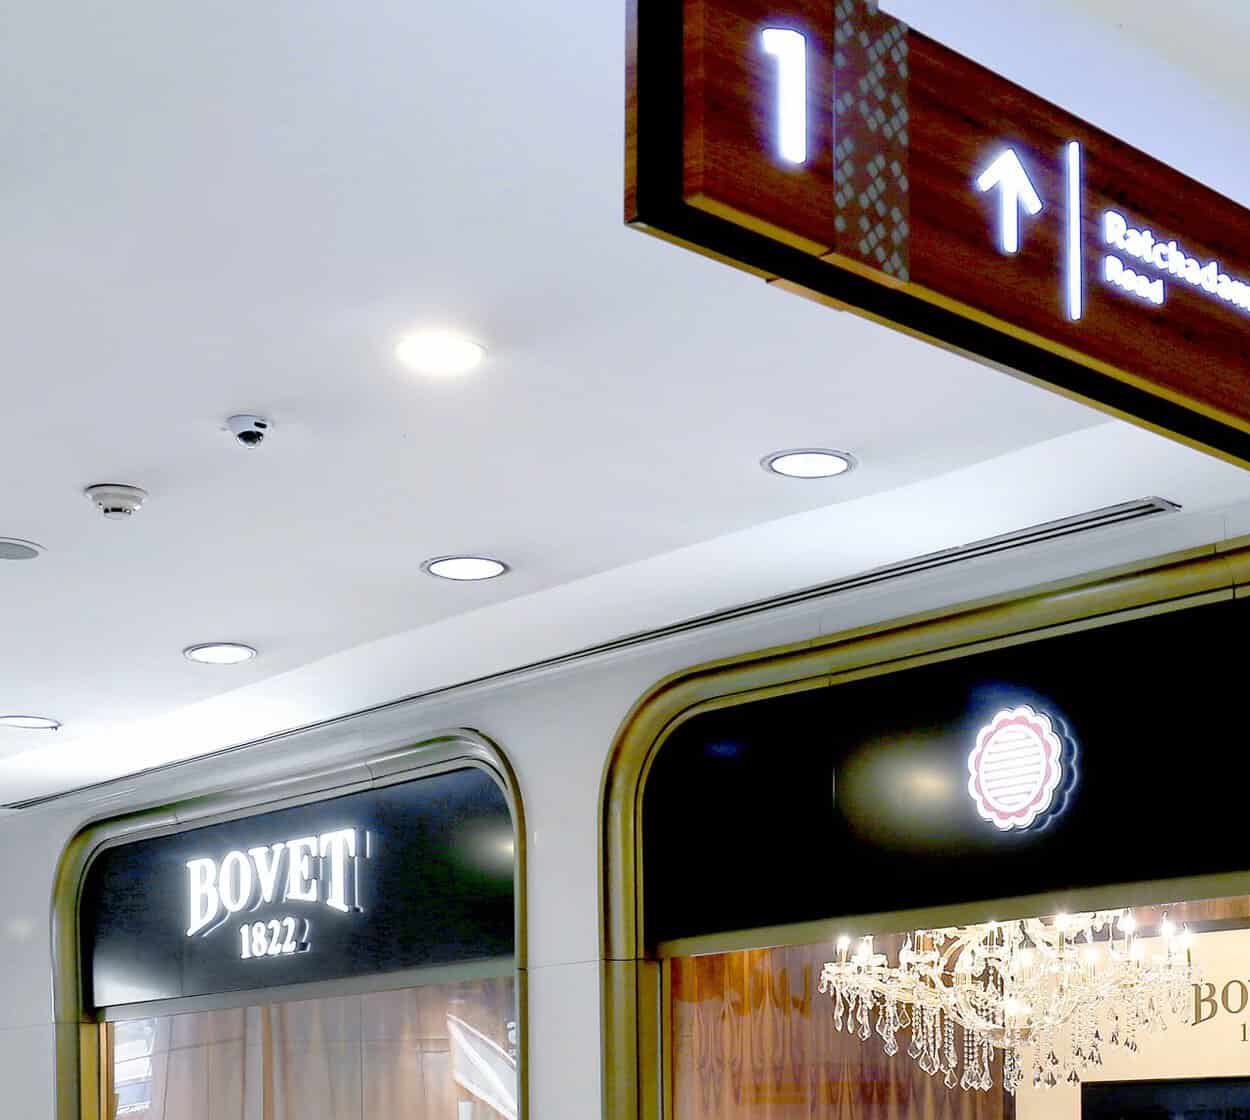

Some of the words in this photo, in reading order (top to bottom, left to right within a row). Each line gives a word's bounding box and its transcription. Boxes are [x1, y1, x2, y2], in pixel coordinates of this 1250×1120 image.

[761, 27, 807, 164] 1
[1105, 255, 1164, 304] Road
[186, 828, 358, 937] BOVET
[240, 916, 299, 959] 1822
